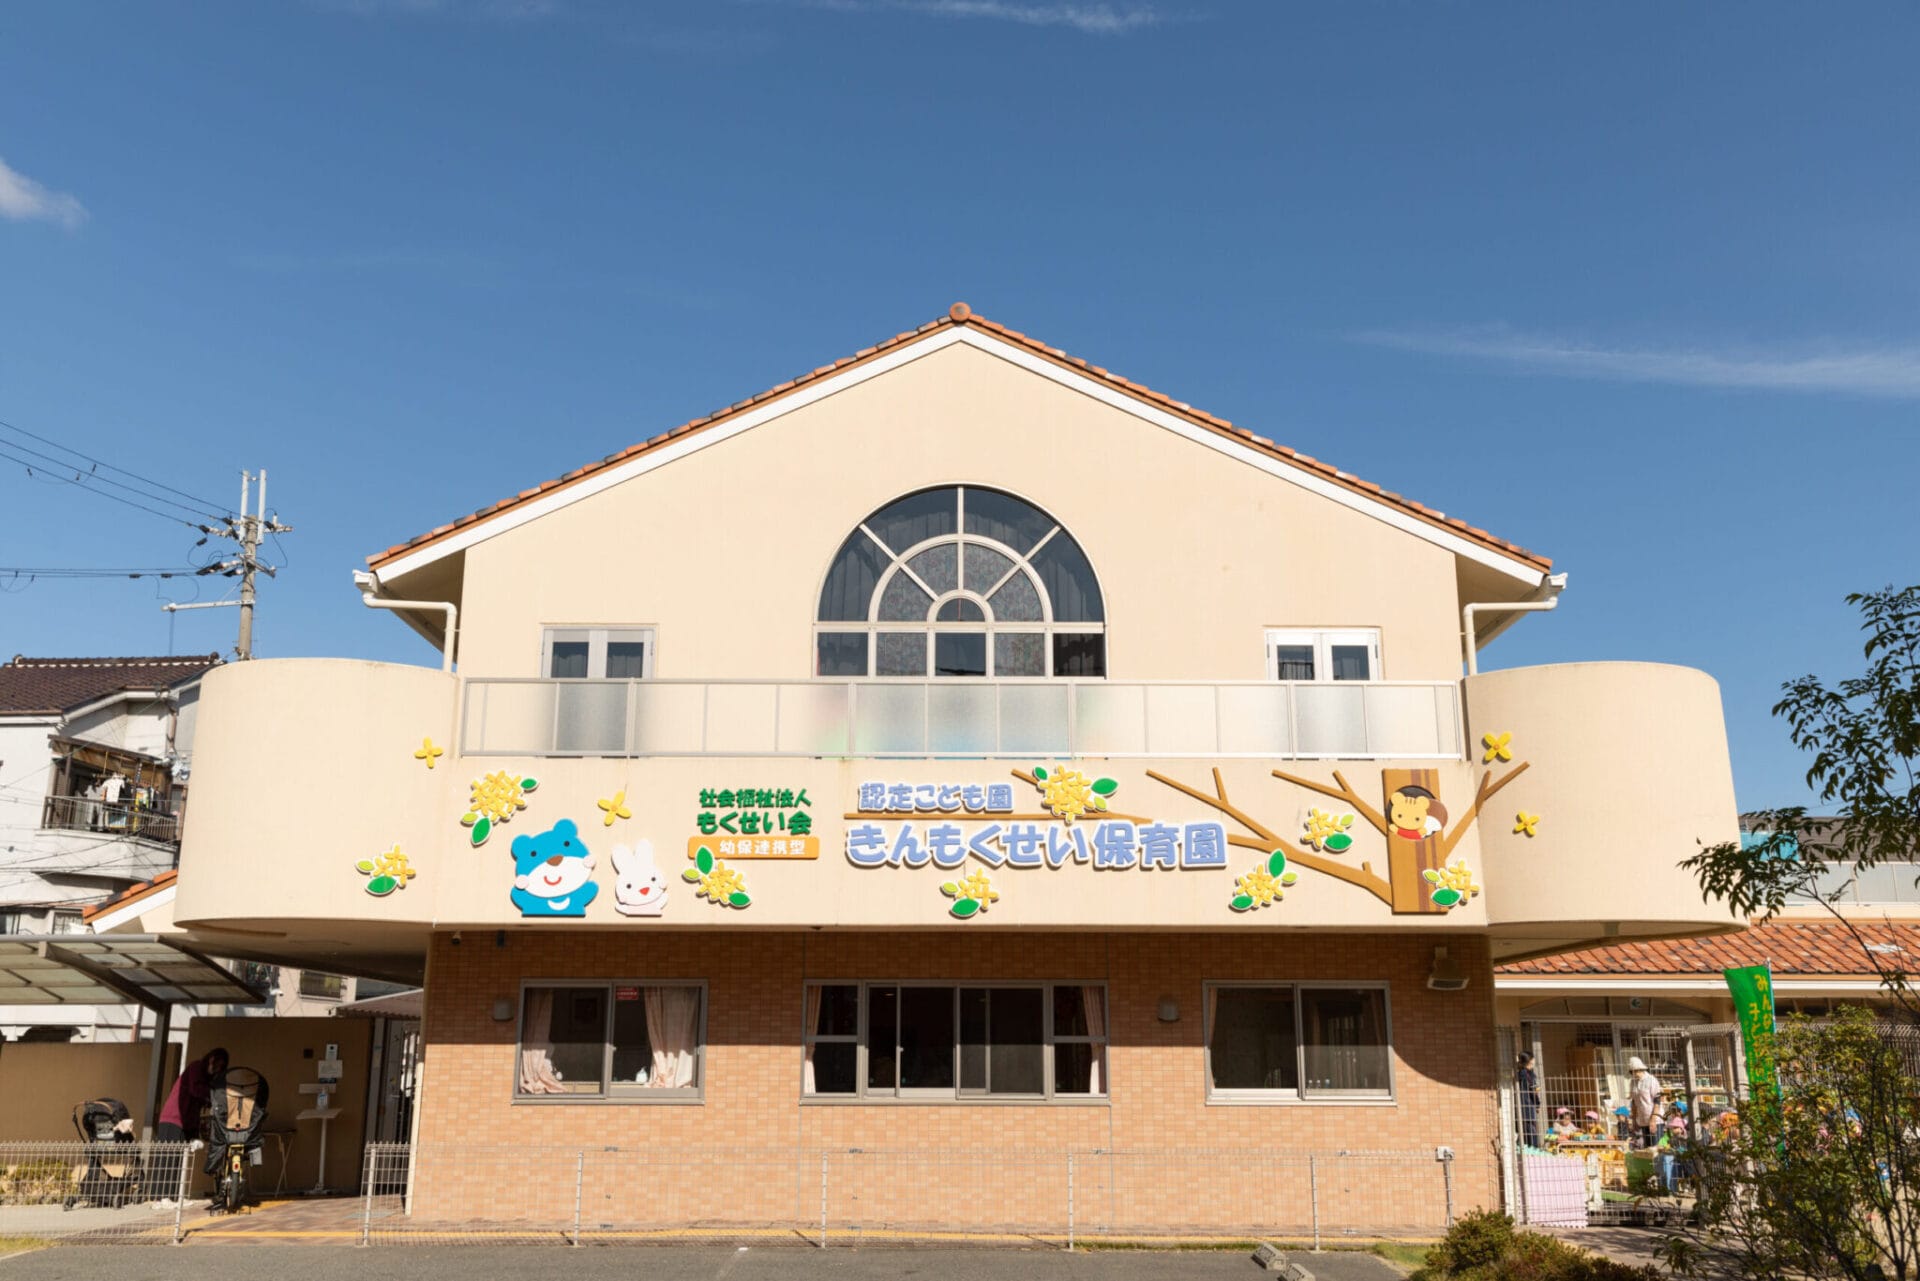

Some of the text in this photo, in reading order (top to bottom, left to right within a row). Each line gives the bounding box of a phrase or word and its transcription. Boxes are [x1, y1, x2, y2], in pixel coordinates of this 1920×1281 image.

[699, 788, 812, 808] 社会福祉法人
[859, 782, 1013, 811] 認定こども園
[696, 810, 812, 835] もくせい会
[719, 839, 806, 855] 幼保連携型
[848, 822, 1228, 866] きんもくせい保育園
